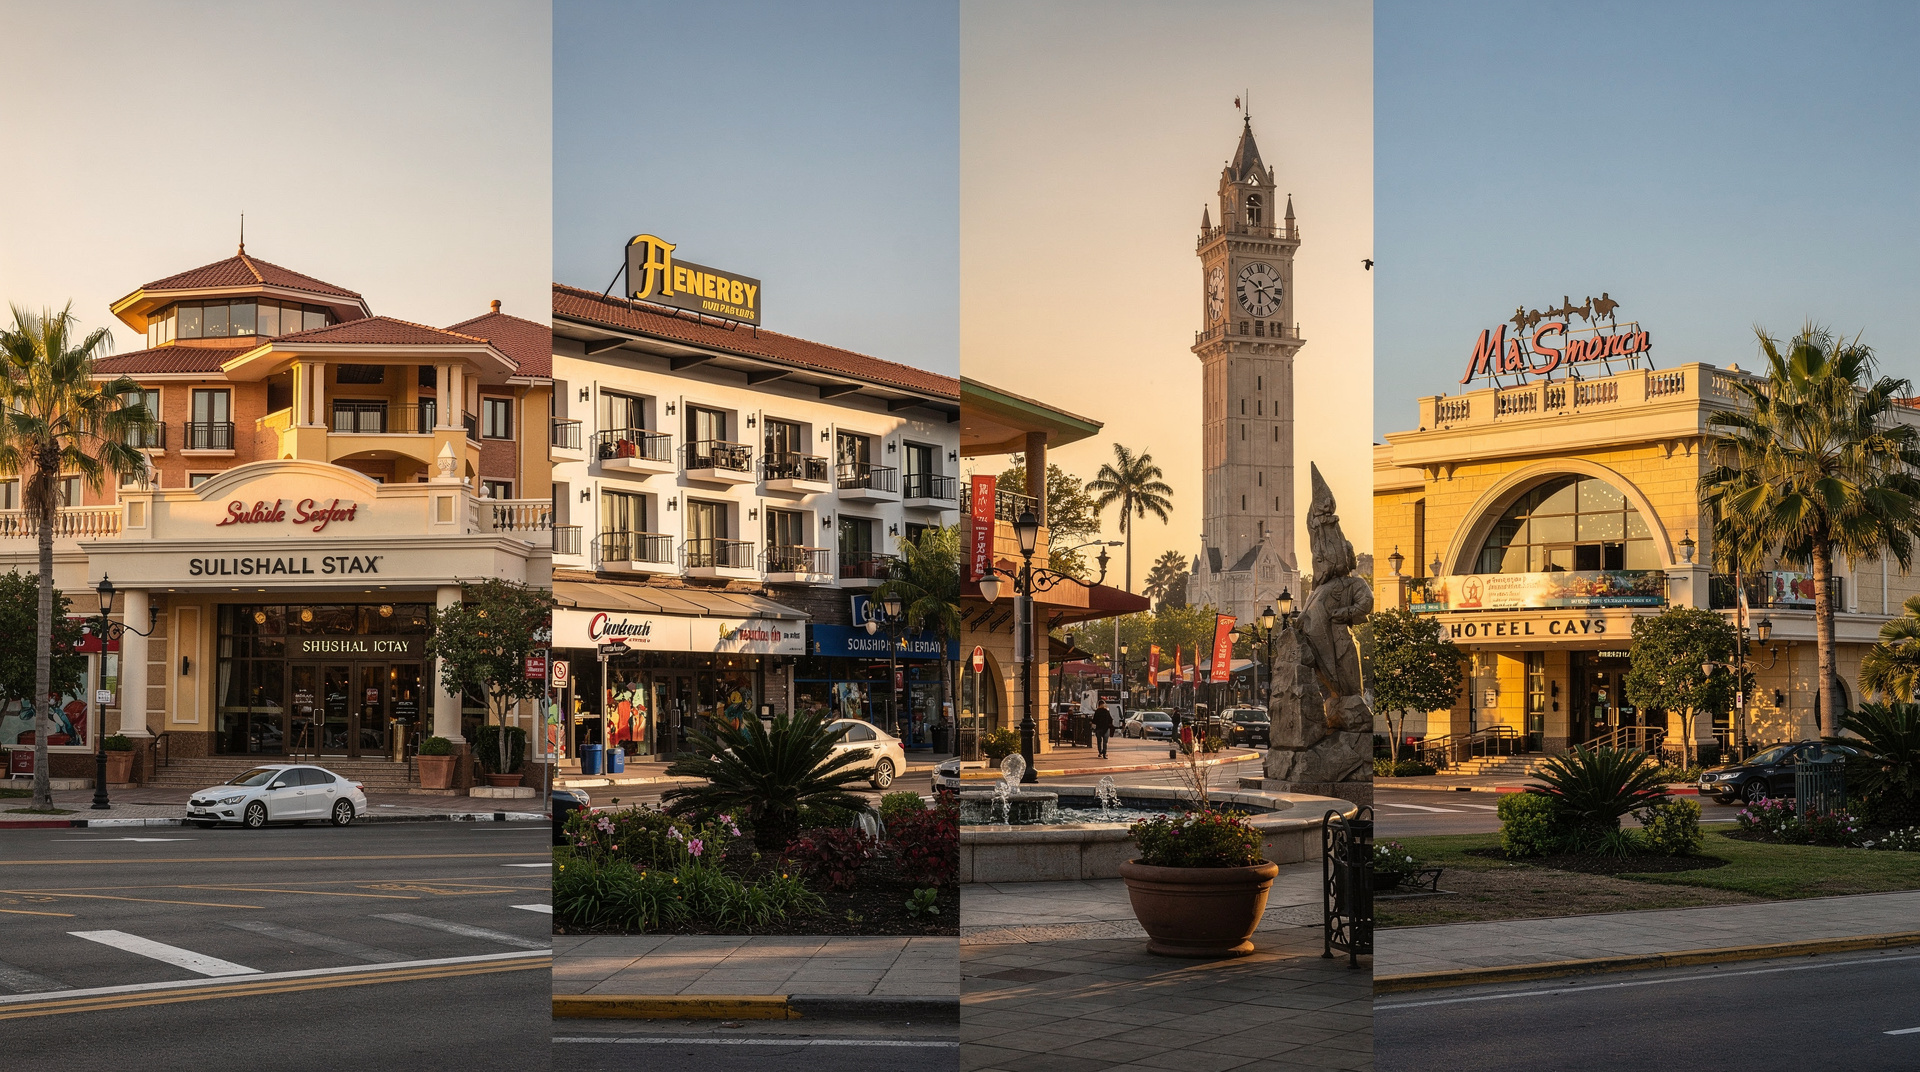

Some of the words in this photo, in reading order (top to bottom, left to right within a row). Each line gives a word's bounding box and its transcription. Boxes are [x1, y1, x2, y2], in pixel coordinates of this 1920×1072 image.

[189, 557, 314, 576] SULISHALL
[1451, 621, 1535, 638] HOTEEL
[1549, 619, 1606, 635] CAYS
